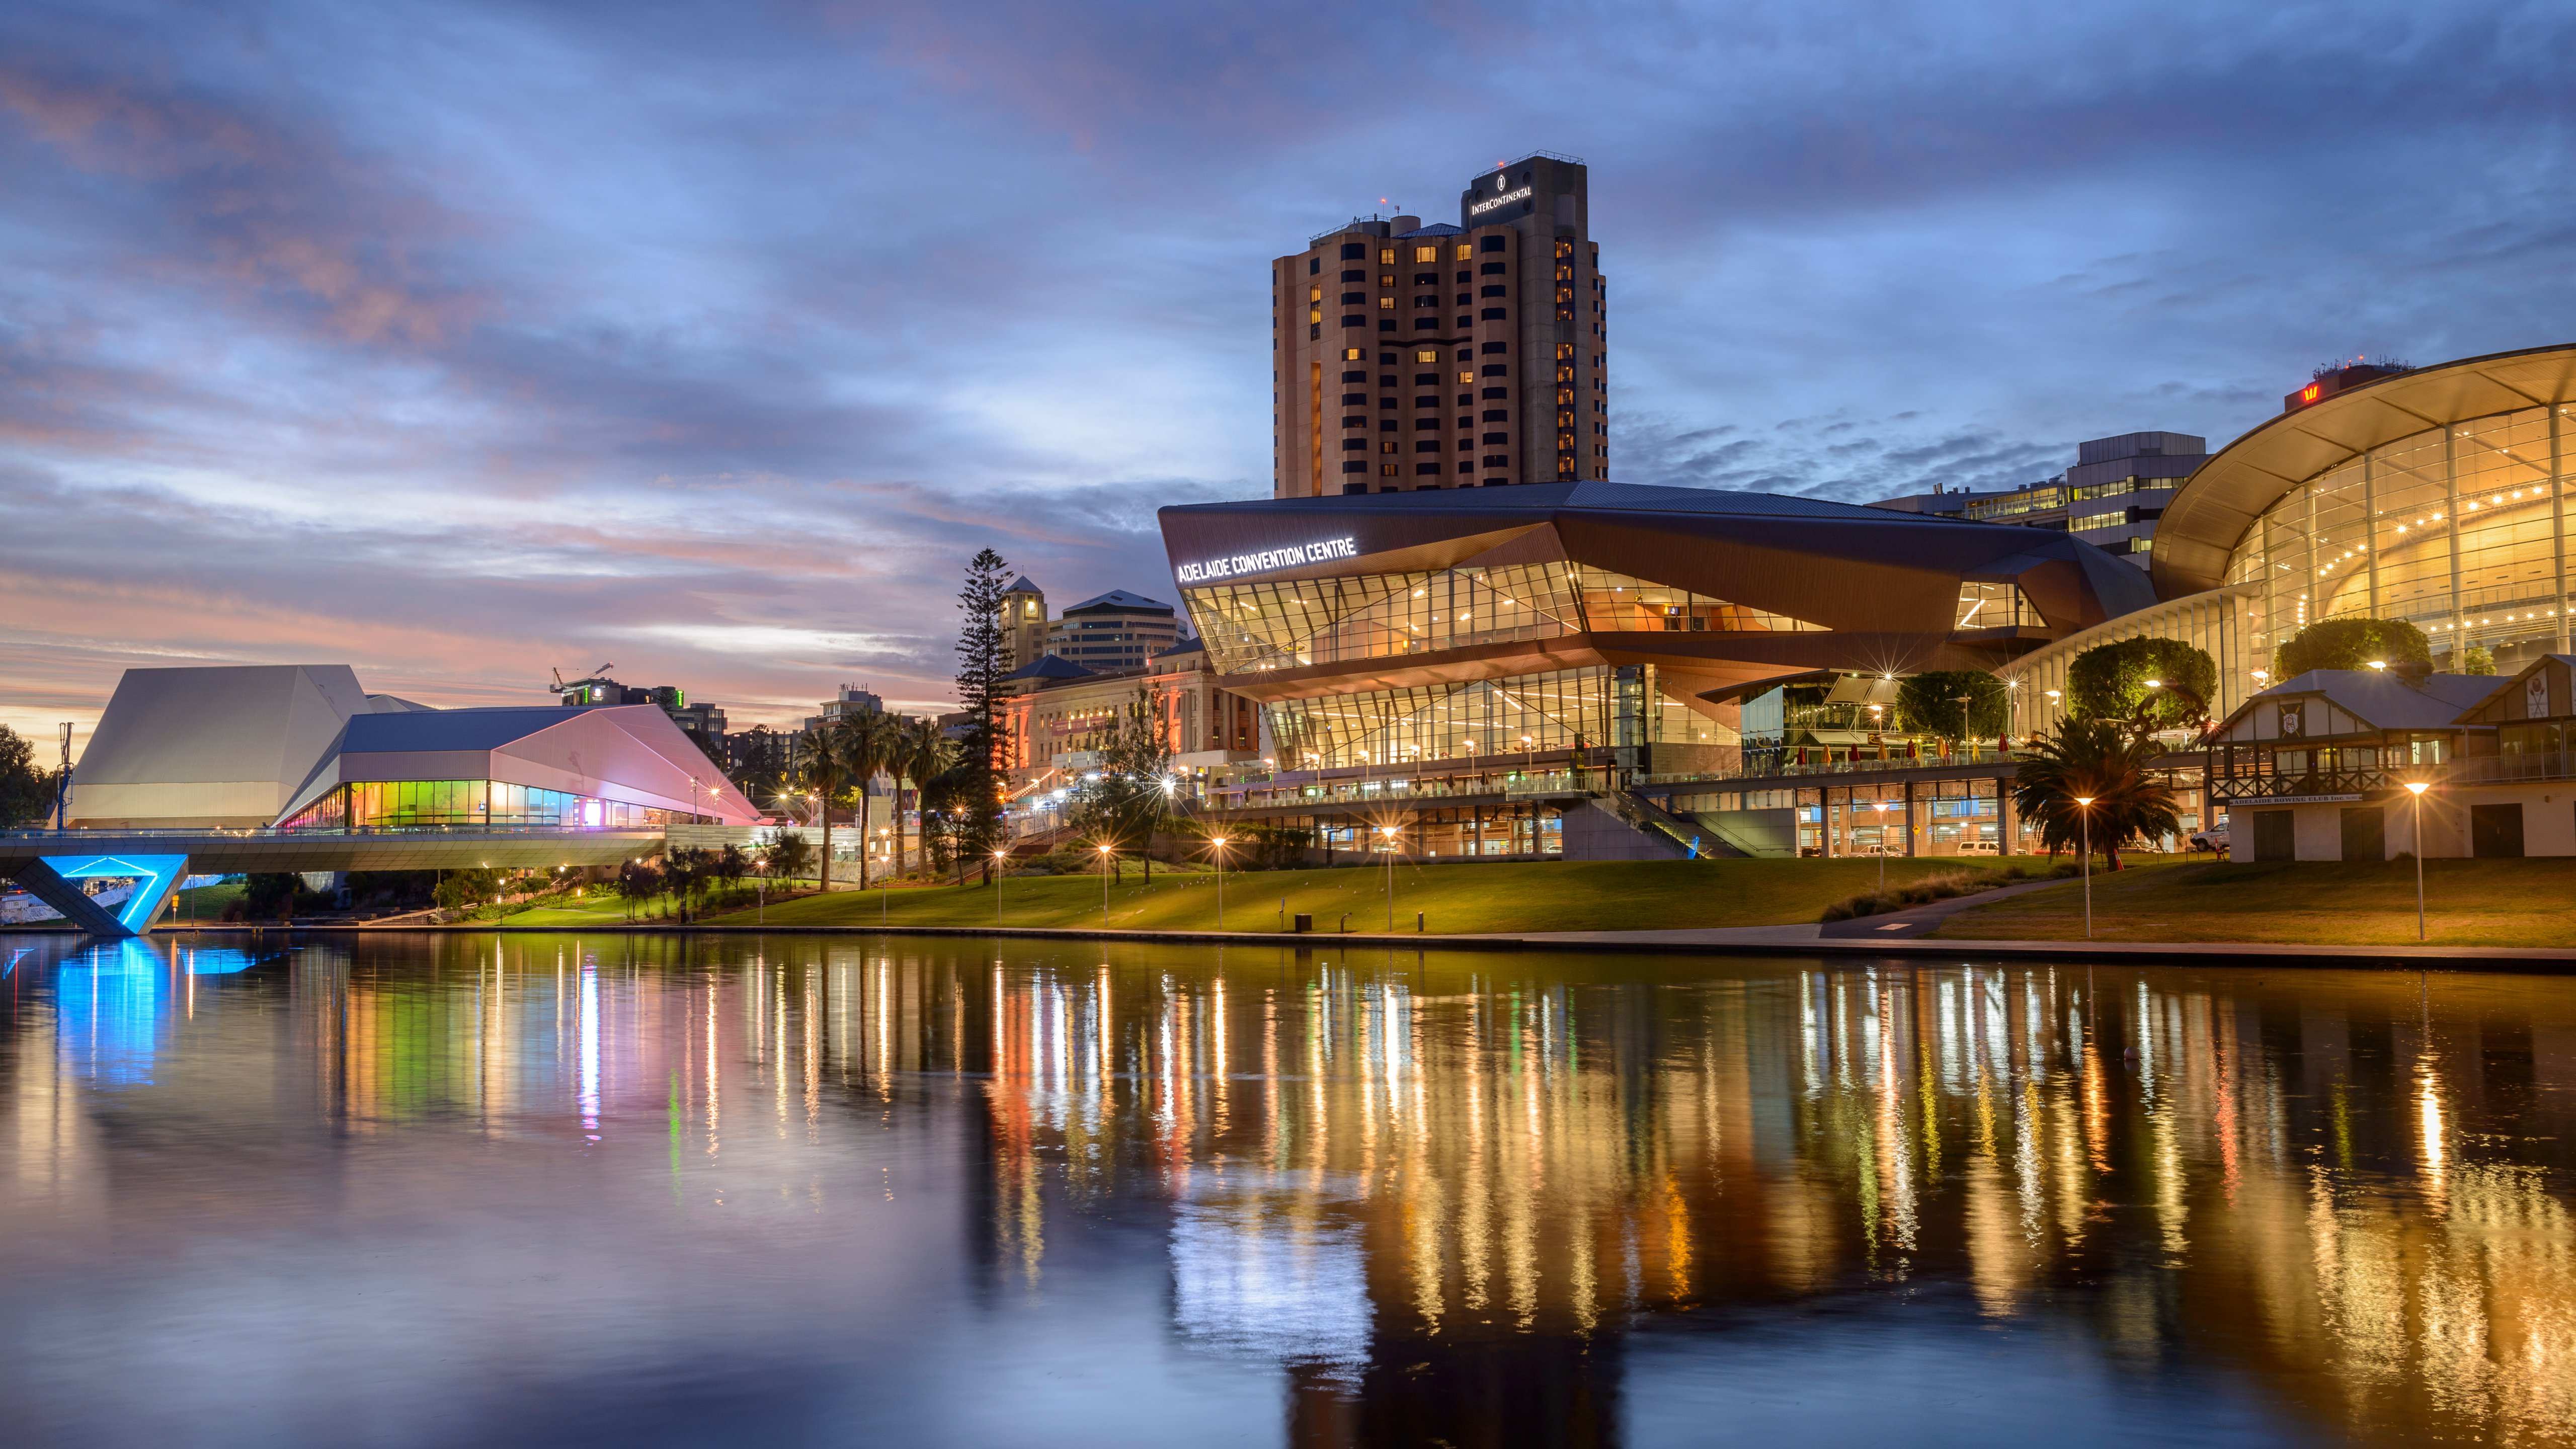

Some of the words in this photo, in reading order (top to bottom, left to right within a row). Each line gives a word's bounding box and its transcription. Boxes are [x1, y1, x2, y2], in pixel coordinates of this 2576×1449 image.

[1472, 187, 1531, 215] INTERCONTINENTAL
[1178, 559, 1231, 583] ADELAIDE
[1232, 546, 1306, 574] CONVENTION
[1307, 537, 1356, 561] CENTRE
